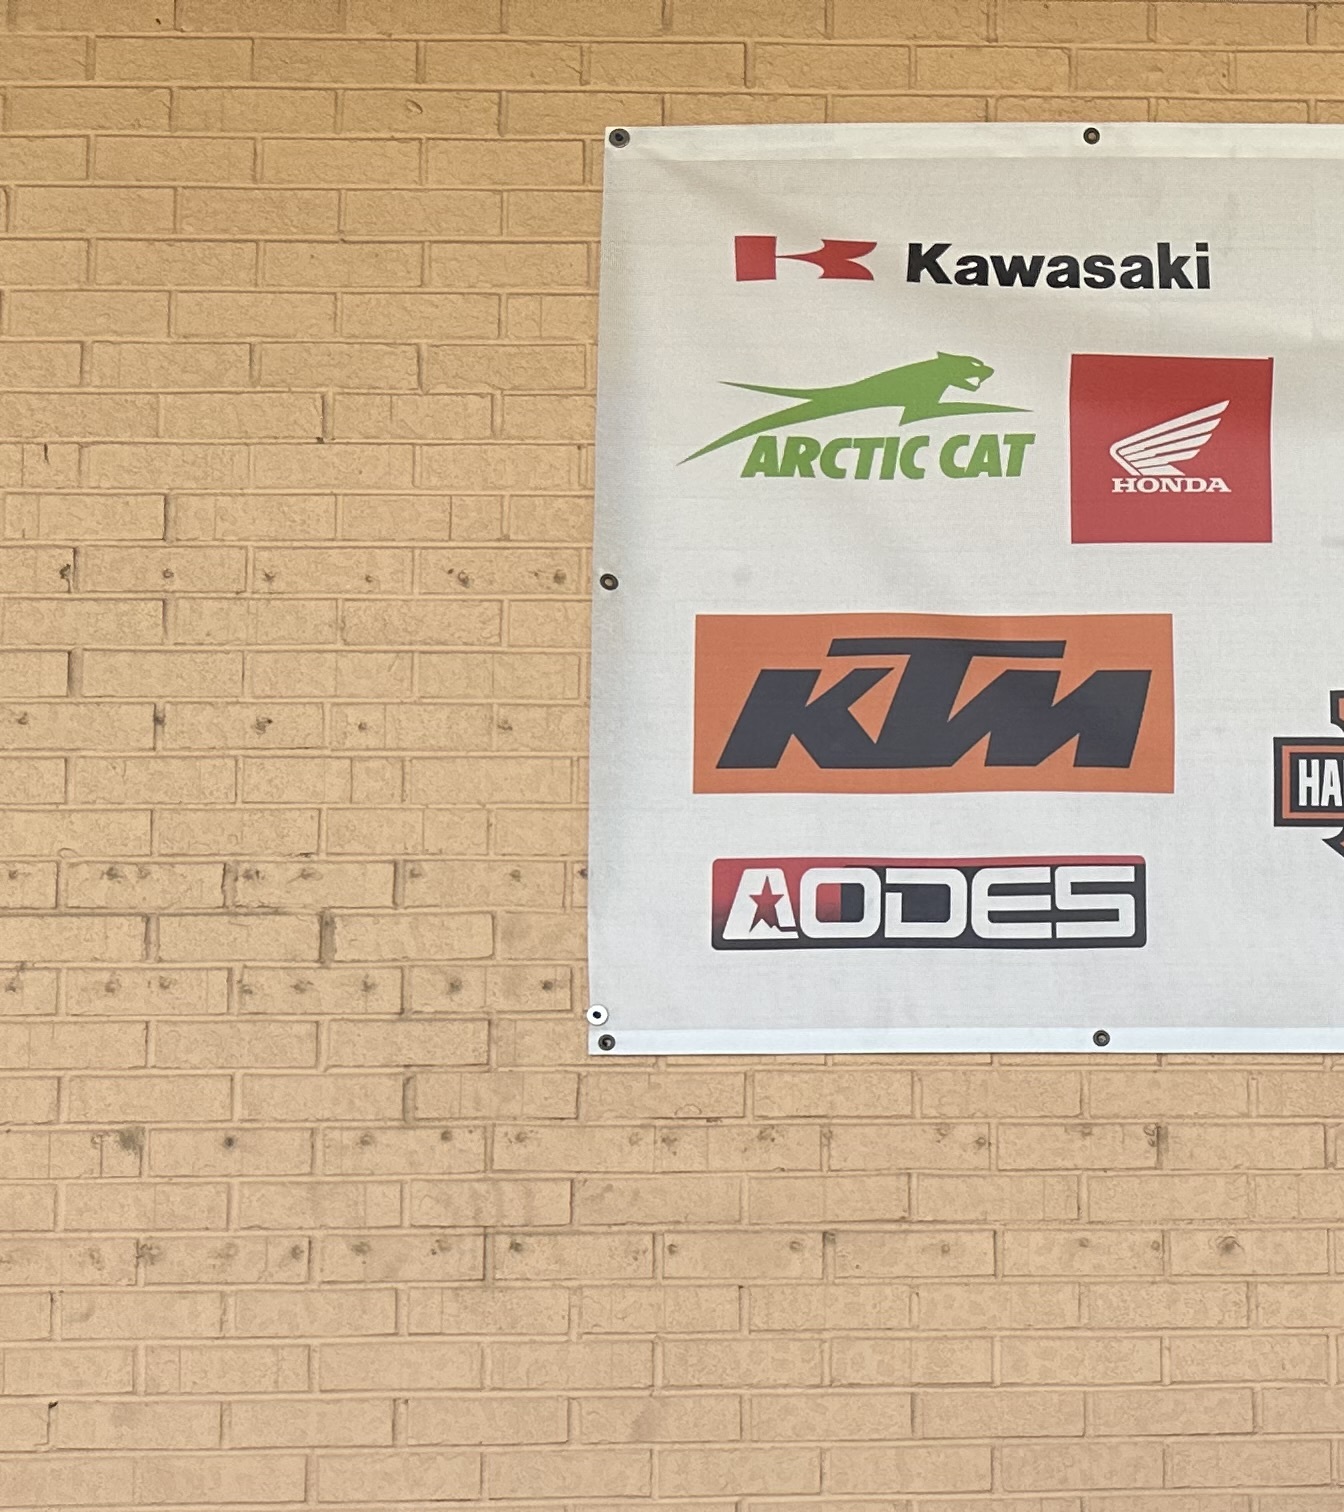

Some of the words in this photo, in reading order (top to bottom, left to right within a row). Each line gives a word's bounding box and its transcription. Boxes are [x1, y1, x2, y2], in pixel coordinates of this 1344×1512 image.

[905, 242, 1211, 290] Kawasaki
[740, 434, 931, 480] ARCTIC
[938, 433, 1036, 479] CAT
[1111, 476, 1232, 494] HONDA
[715, 637, 1152, 769] KTM
[722, 866, 1139, 941] AODES
